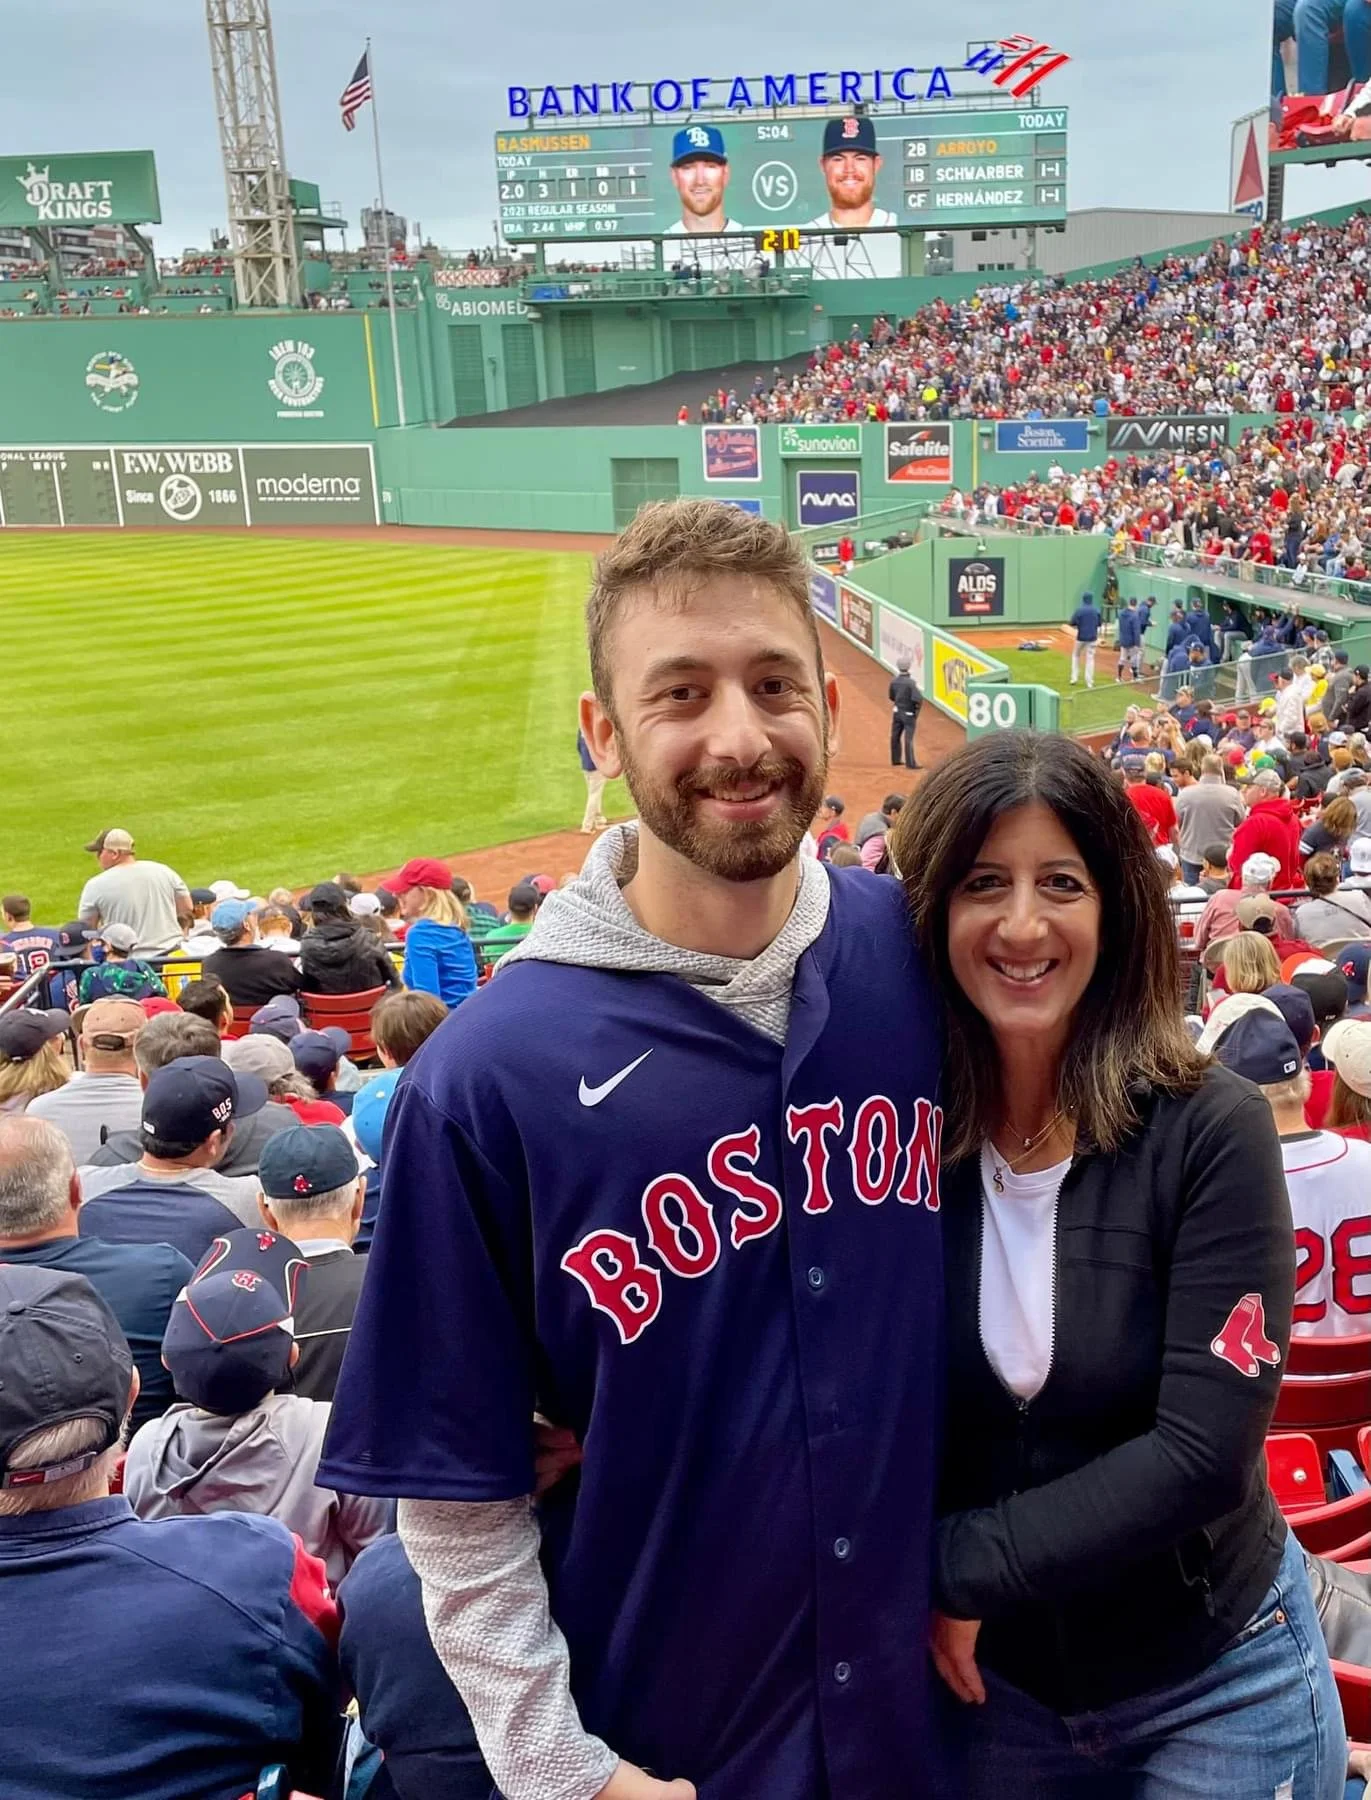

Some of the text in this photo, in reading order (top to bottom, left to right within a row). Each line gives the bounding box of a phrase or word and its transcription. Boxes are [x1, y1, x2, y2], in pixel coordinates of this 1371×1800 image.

[507, 65, 953, 119] BANK OF AMERICA
[1018, 113, 1065, 128] TODAY
[757, 126, 789, 139] 5:04
[496, 134, 591, 152] RASMUSSEN
[907, 139, 997, 157] 2B ARROYO
[497, 156, 532, 167] TODAY
[910, 168, 924, 183] 1B
[936, 164, 1024, 181] SCHWARBER
[26, 180, 112, 205] DRAFT
[501, 183, 524, 199] 2.0
[539, 183, 548, 197] 3
[598, 181, 609, 196] 0
[760, 175, 789, 198] VS
[907, 193, 927, 208] CF
[936, 188, 1024, 207] HERNÁNDEZ
[38, 200, 112, 220] KINGS
[528, 204, 573, 216] REGULAR
[576, 203, 616, 215] SEASON
[594, 220, 618, 231] 0.97
[451, 300, 528, 316] ABIOMED
[797, 435, 856, 451] sunovion
[889, 440, 949, 456] Safelite
[28, 452, 65, 461] LEAGUE
[122, 452, 234, 474] F.W. WEBB
[256, 472, 361, 494] moderna
[126, 489, 154, 503] Since
[957, 574, 997, 593] ALDS
[968, 692, 1017, 728] 80
[212, 1097, 232, 1120] BOS
[560, 1094, 943, 1345] BOSTON
